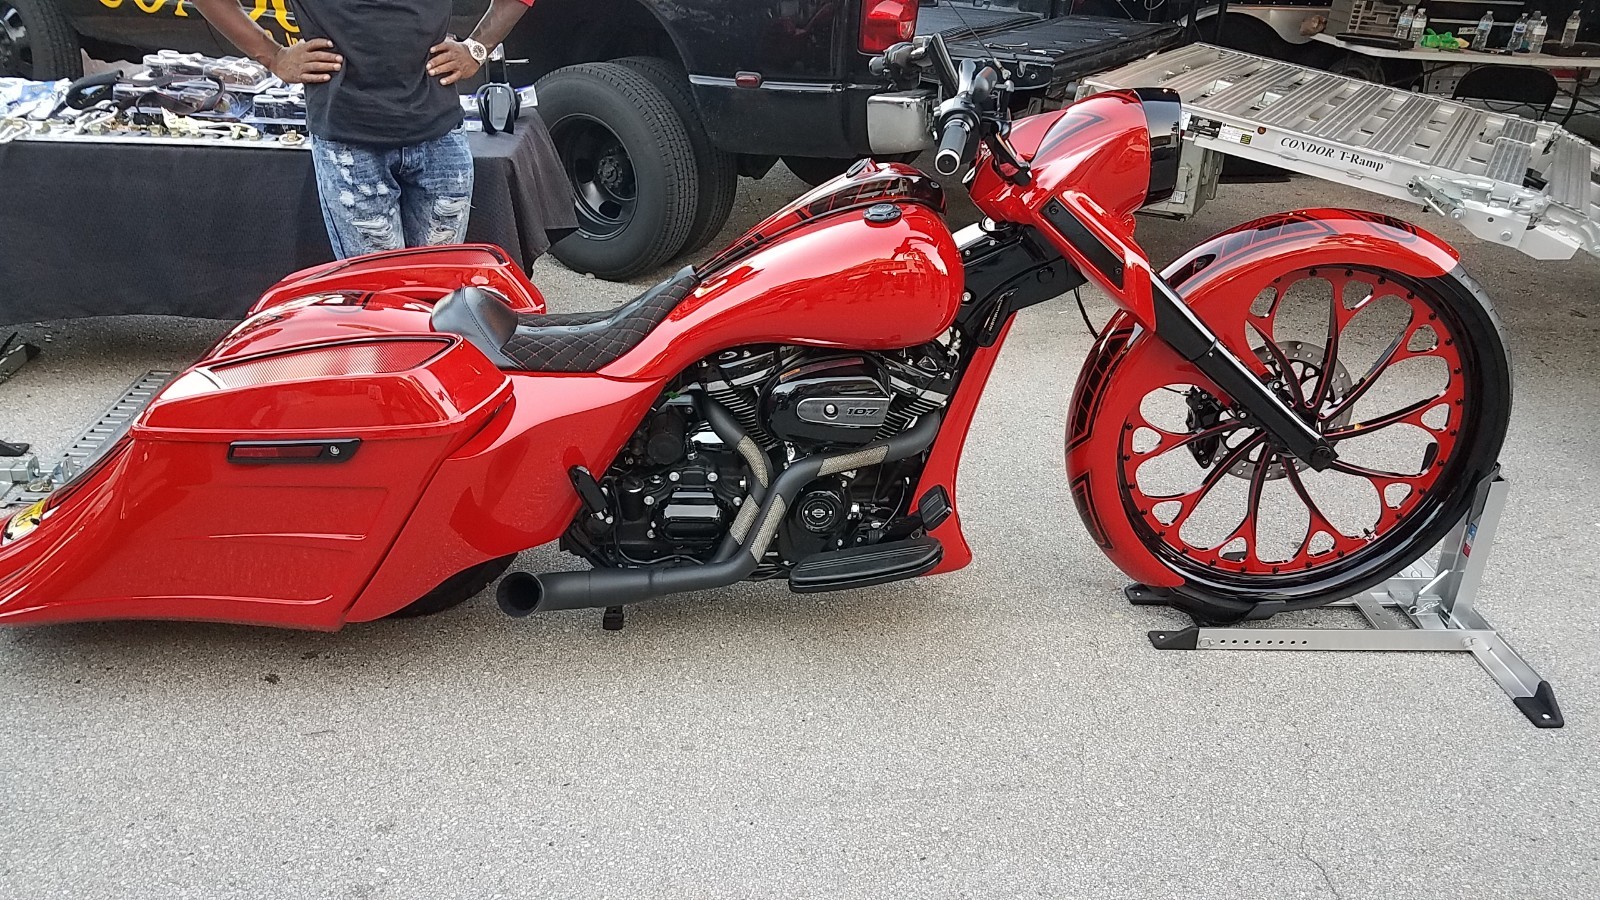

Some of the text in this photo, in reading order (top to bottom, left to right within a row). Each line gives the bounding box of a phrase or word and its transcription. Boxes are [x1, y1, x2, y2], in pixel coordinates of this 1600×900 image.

[1280, 137, 1384, 172] CONDOR T-Ramp
[847, 407, 880, 416] 107
